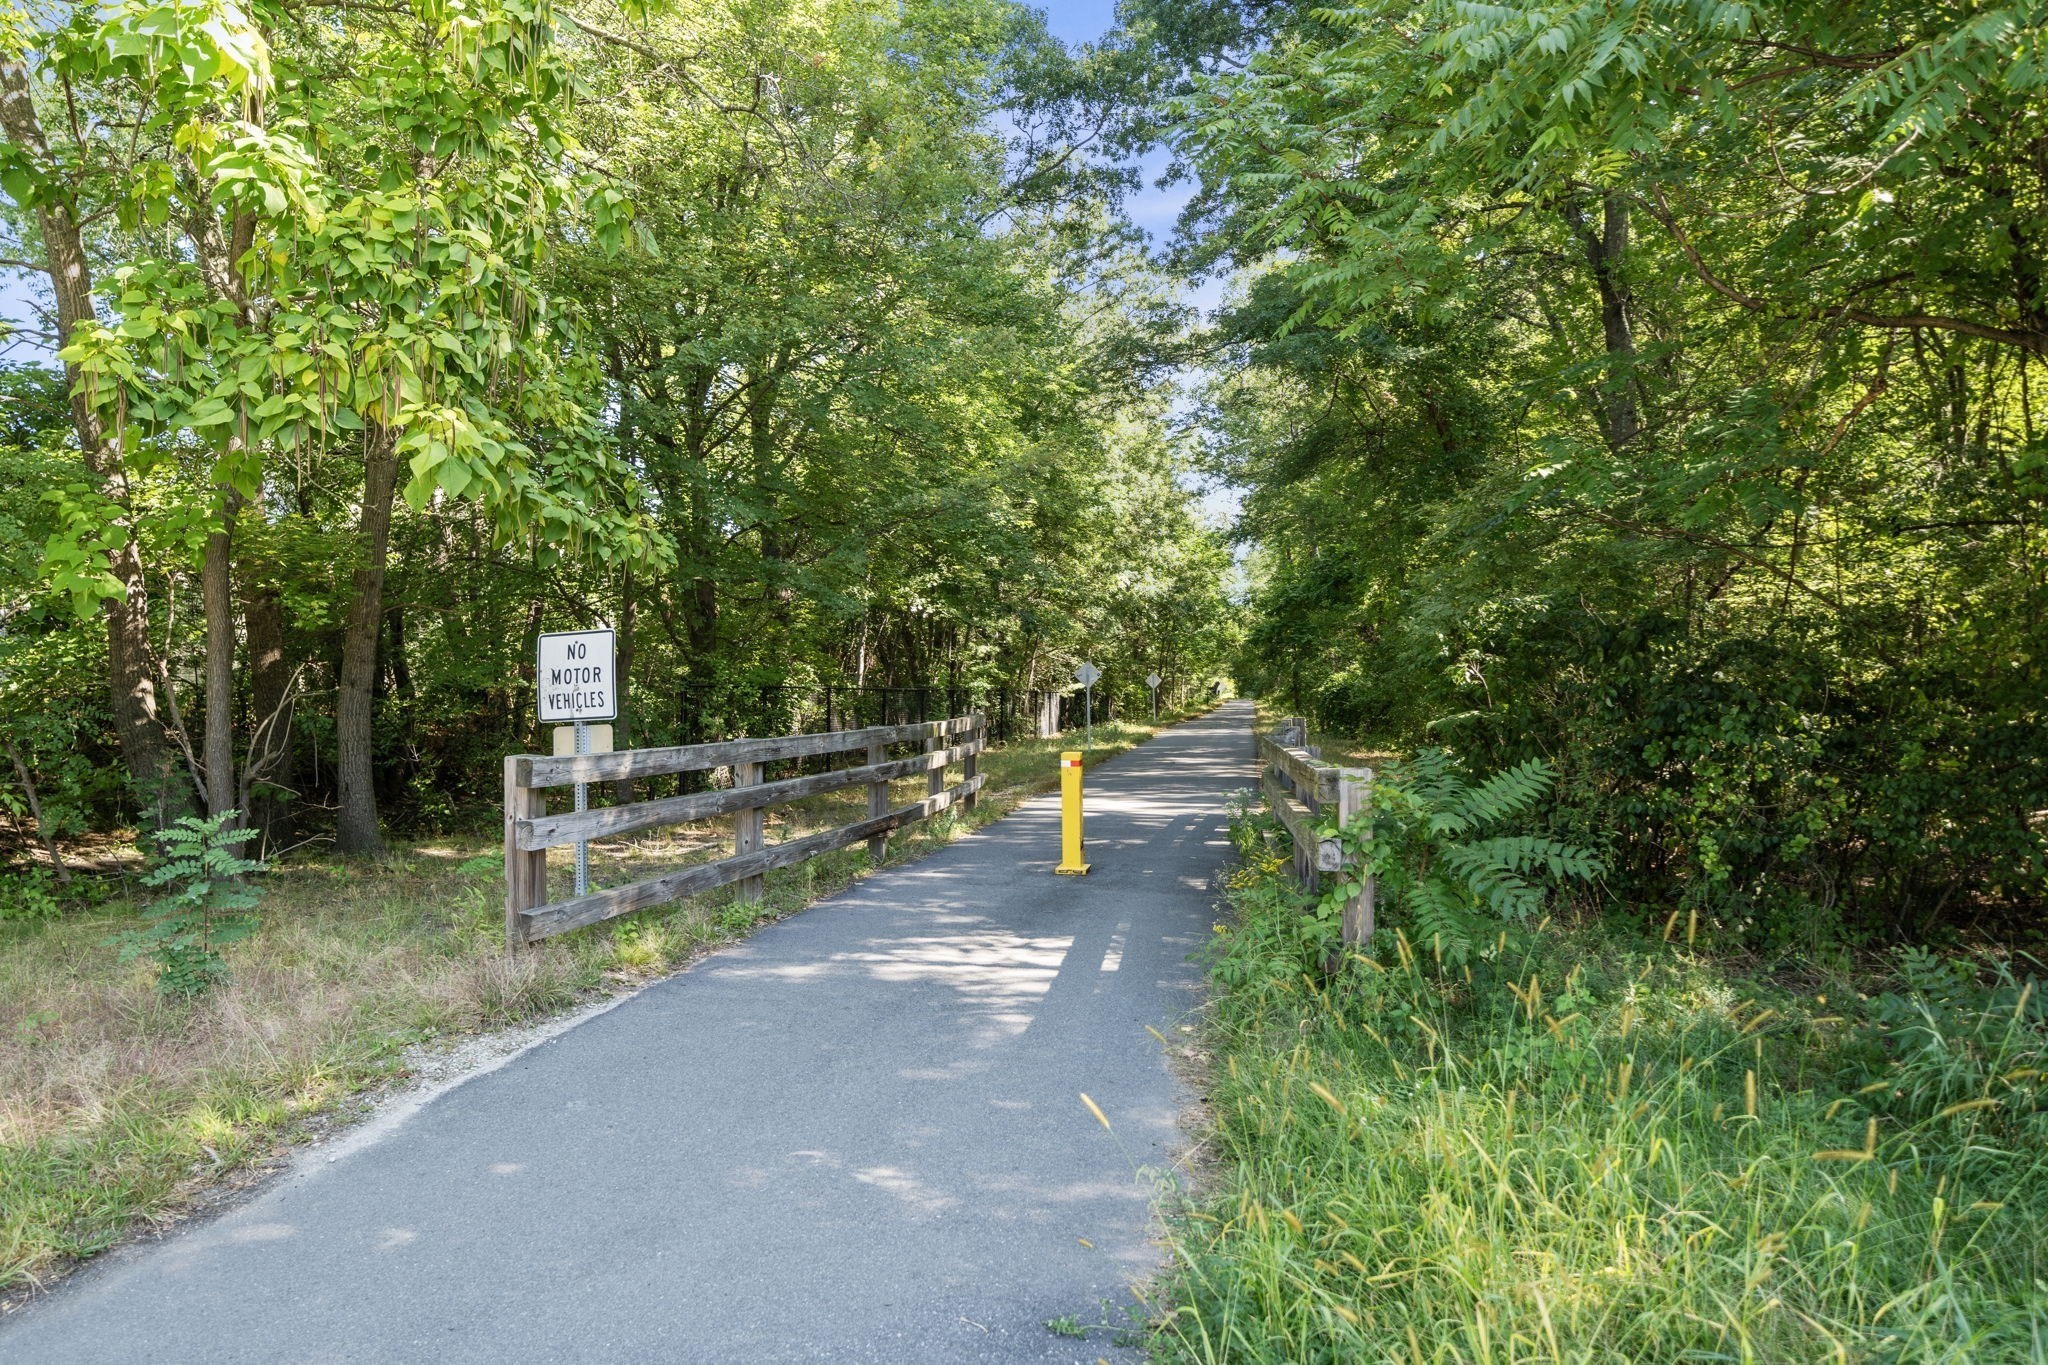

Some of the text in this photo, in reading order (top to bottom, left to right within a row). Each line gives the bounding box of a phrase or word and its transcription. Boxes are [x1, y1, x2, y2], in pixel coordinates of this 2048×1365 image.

[567, 643, 586, 660] NO
[551, 667, 601, 685] MOTOR
[549, 691, 604, 709] VEHICLES
